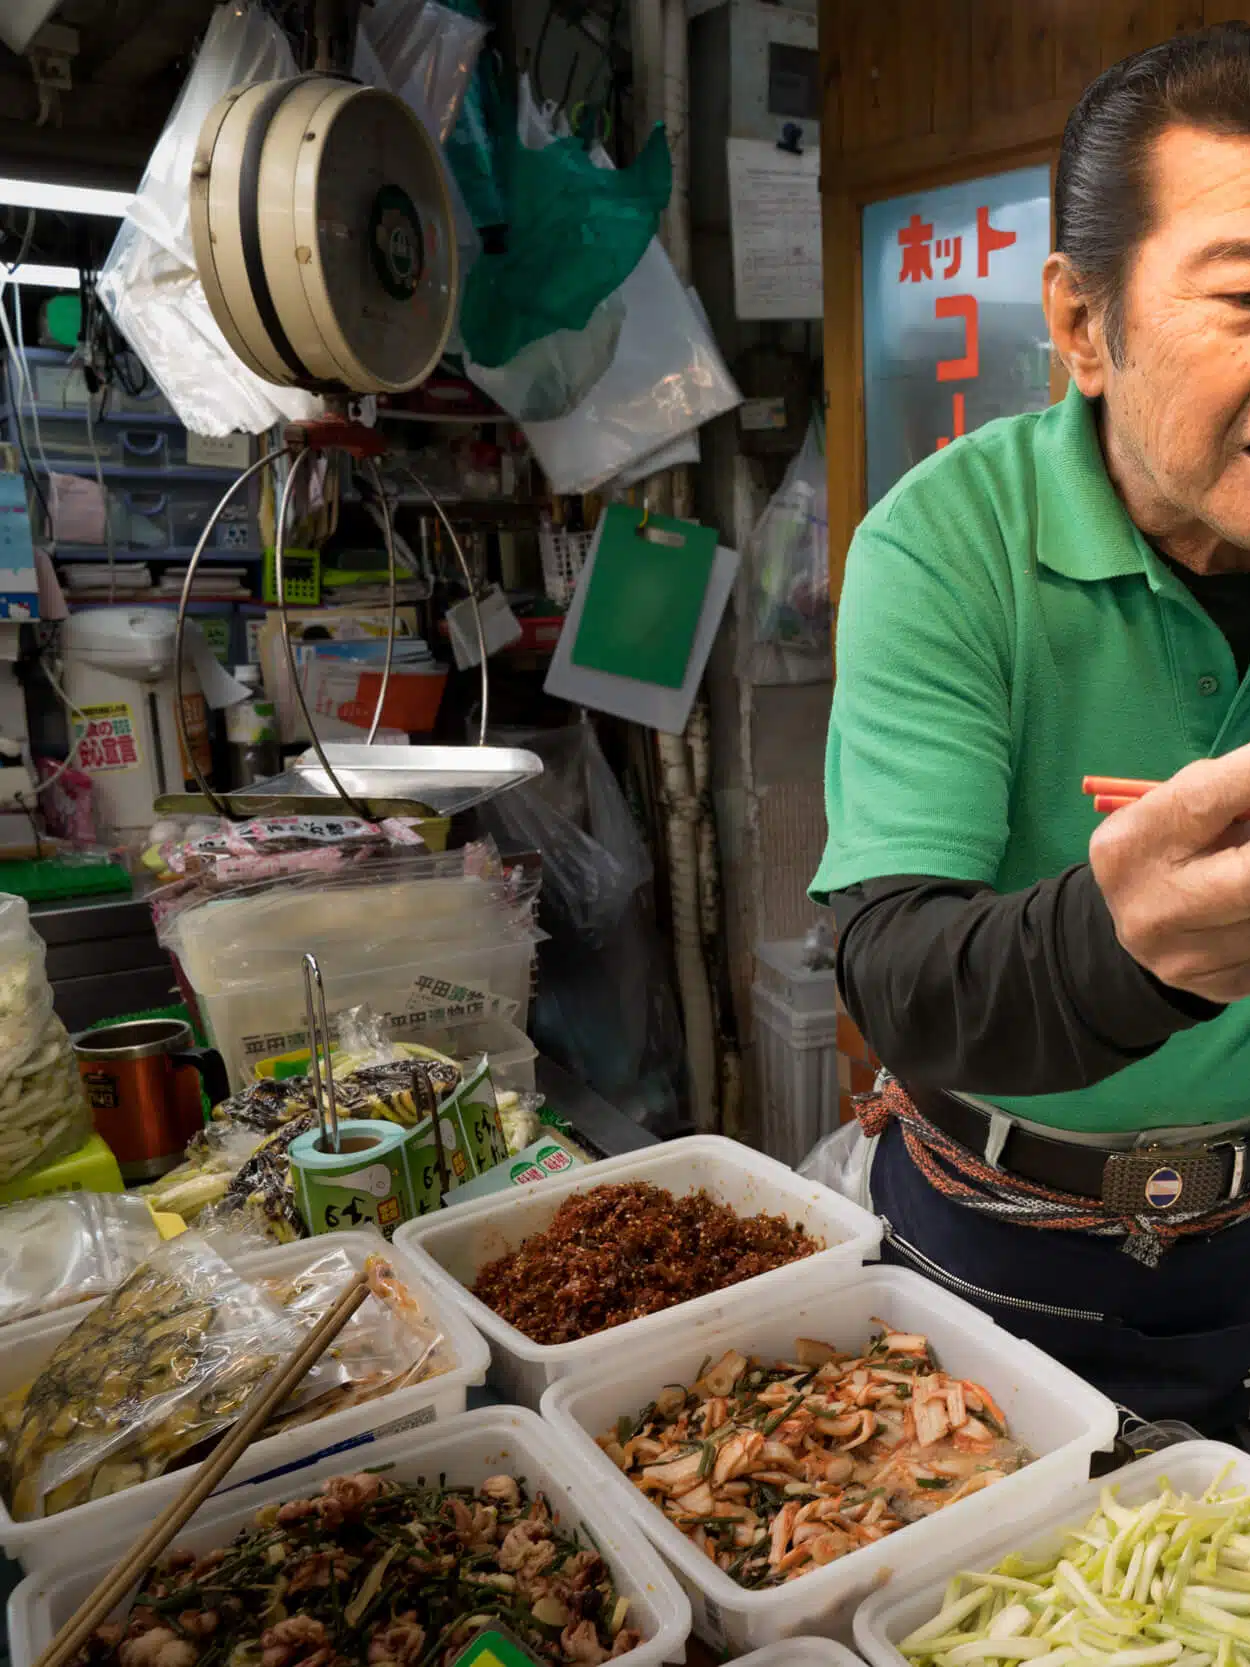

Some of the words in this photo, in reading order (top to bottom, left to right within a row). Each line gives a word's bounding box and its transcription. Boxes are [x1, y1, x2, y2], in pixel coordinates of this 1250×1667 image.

[898, 206, 1017, 283] ホット
[935, 293, 980, 451] コー
